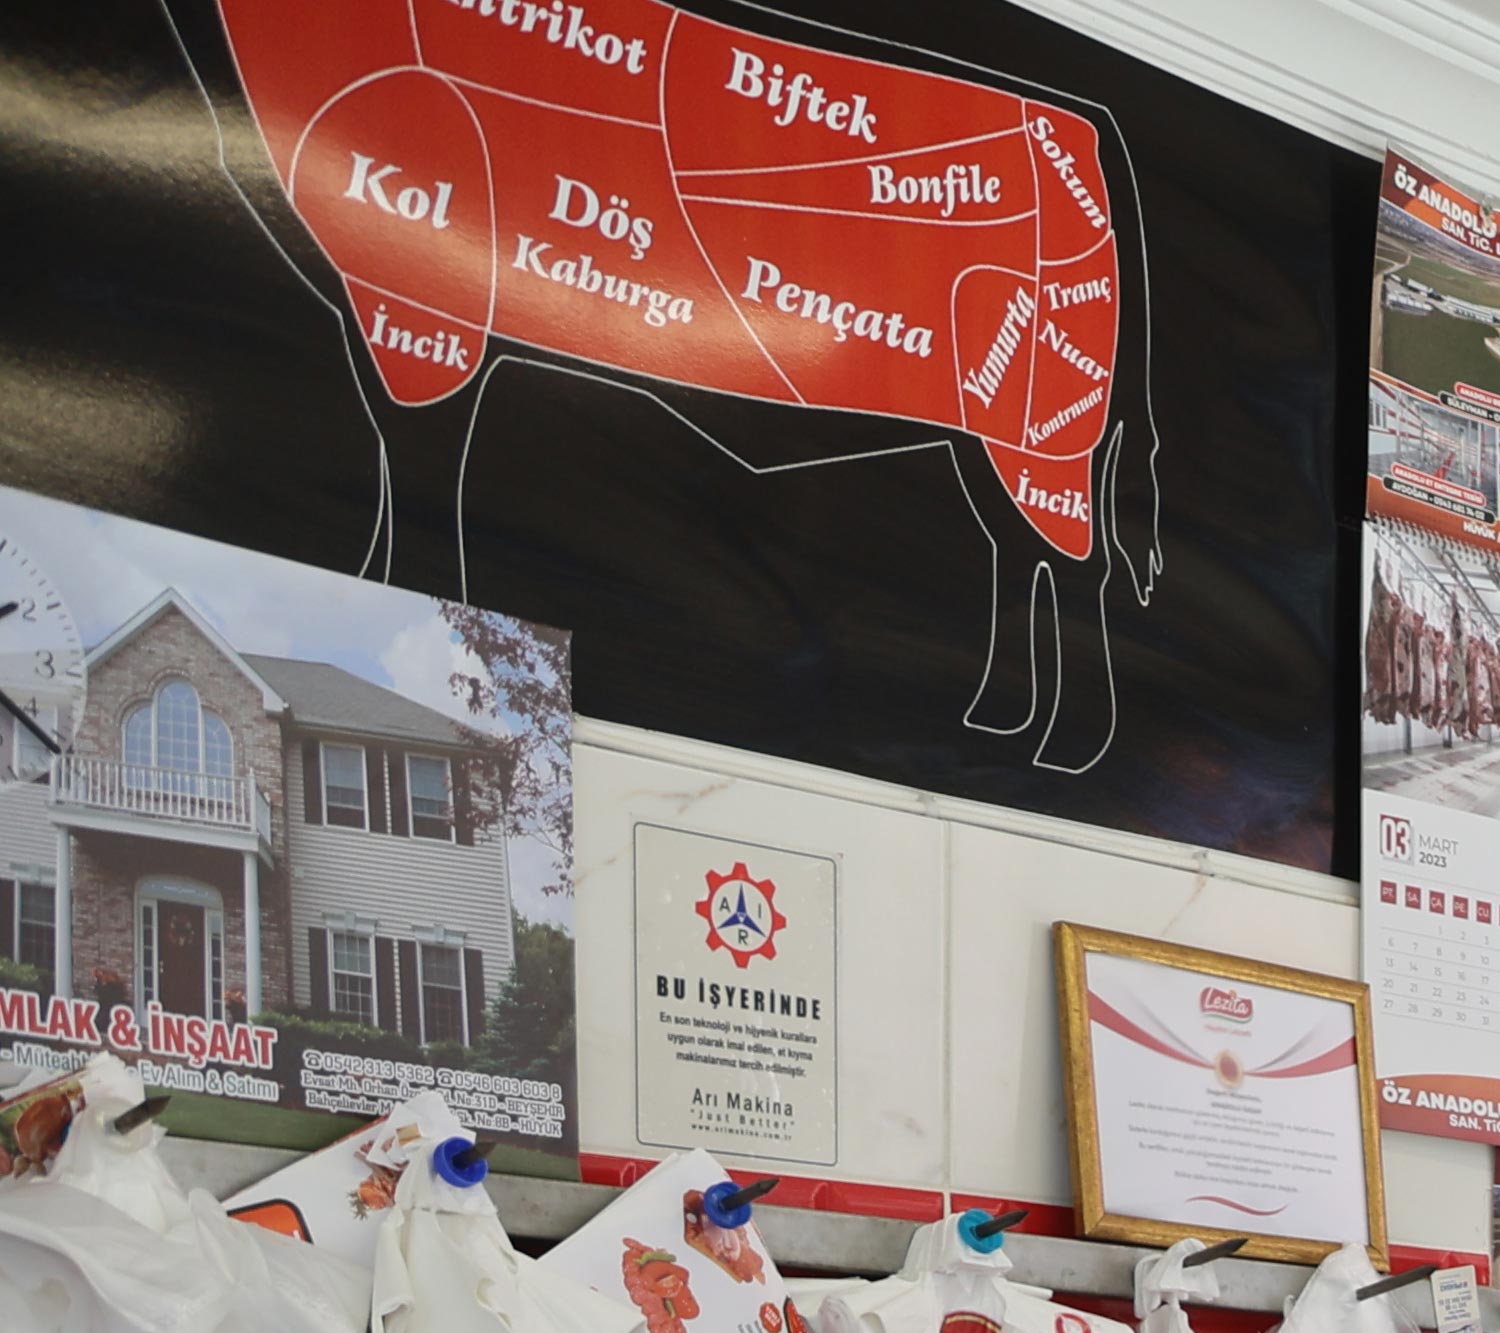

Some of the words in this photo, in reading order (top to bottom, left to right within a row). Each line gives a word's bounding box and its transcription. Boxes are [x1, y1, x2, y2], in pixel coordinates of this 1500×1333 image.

[449, 0, 648, 74] trikot
[725, 47, 878, 143] Biftek
[343, 150, 453, 230] Kol
[867, 163, 1001, 218] Bonfile
[1026, 114, 1108, 229] Sokum
[548, 173, 654, 259] Döş
[1394, 164, 1416, 197] ÖZ
[1419, 184, 1497, 238] ANADOLU
[511, 234, 694, 328] Kaburga
[741, 256, 934, 358] Pençata
[1043, 275, 1112, 312] Tranç
[369, 304, 469, 371] İncik
[961, 286, 1035, 410] Yumurta
[1038, 319, 1110, 382] Nuar
[1015, 469, 1089, 523] İncik
[1380, 817, 1412, 859] 03
[1419, 834, 1459, 856] MART
[1419, 852, 1447, 869] 2023
[656, 975, 687, 1000] BU
[698, 977, 822, 1021] İŞYERİNDE
[1203, 989, 1249, 1015] Lezita
[0, 991, 100, 1043] MLAK
[107, 1010, 142, 1051] &
[149, 1001, 279, 1070] İNŞAAT
[674, 1014, 691, 1027] son
[693, 1017, 731, 1034] teknoloji
[780, 1030, 818, 1045] kurallara
[139, 1061, 163, 1084] Ev
[165, 1064, 203, 1090] Alım
[206, 1070, 224, 1094] &
[225, 1072, 280, 1101] Satımı
[323, 1052, 363, 1074] 0542
[364, 1057, 394, 1078] 313
[395, 1062, 435, 1085] 5362
[454, 1071, 493, 1091] 0546
[492, 1077, 521, 1096] 603
[523, 1081, 550, 1100] 603
[550, 1084, 562, 1100] 8
[692, 1088, 719, 1107] Arı
[726, 1092, 794, 1117] Makina
[1381, 1079, 1413, 1106] ÖZ
